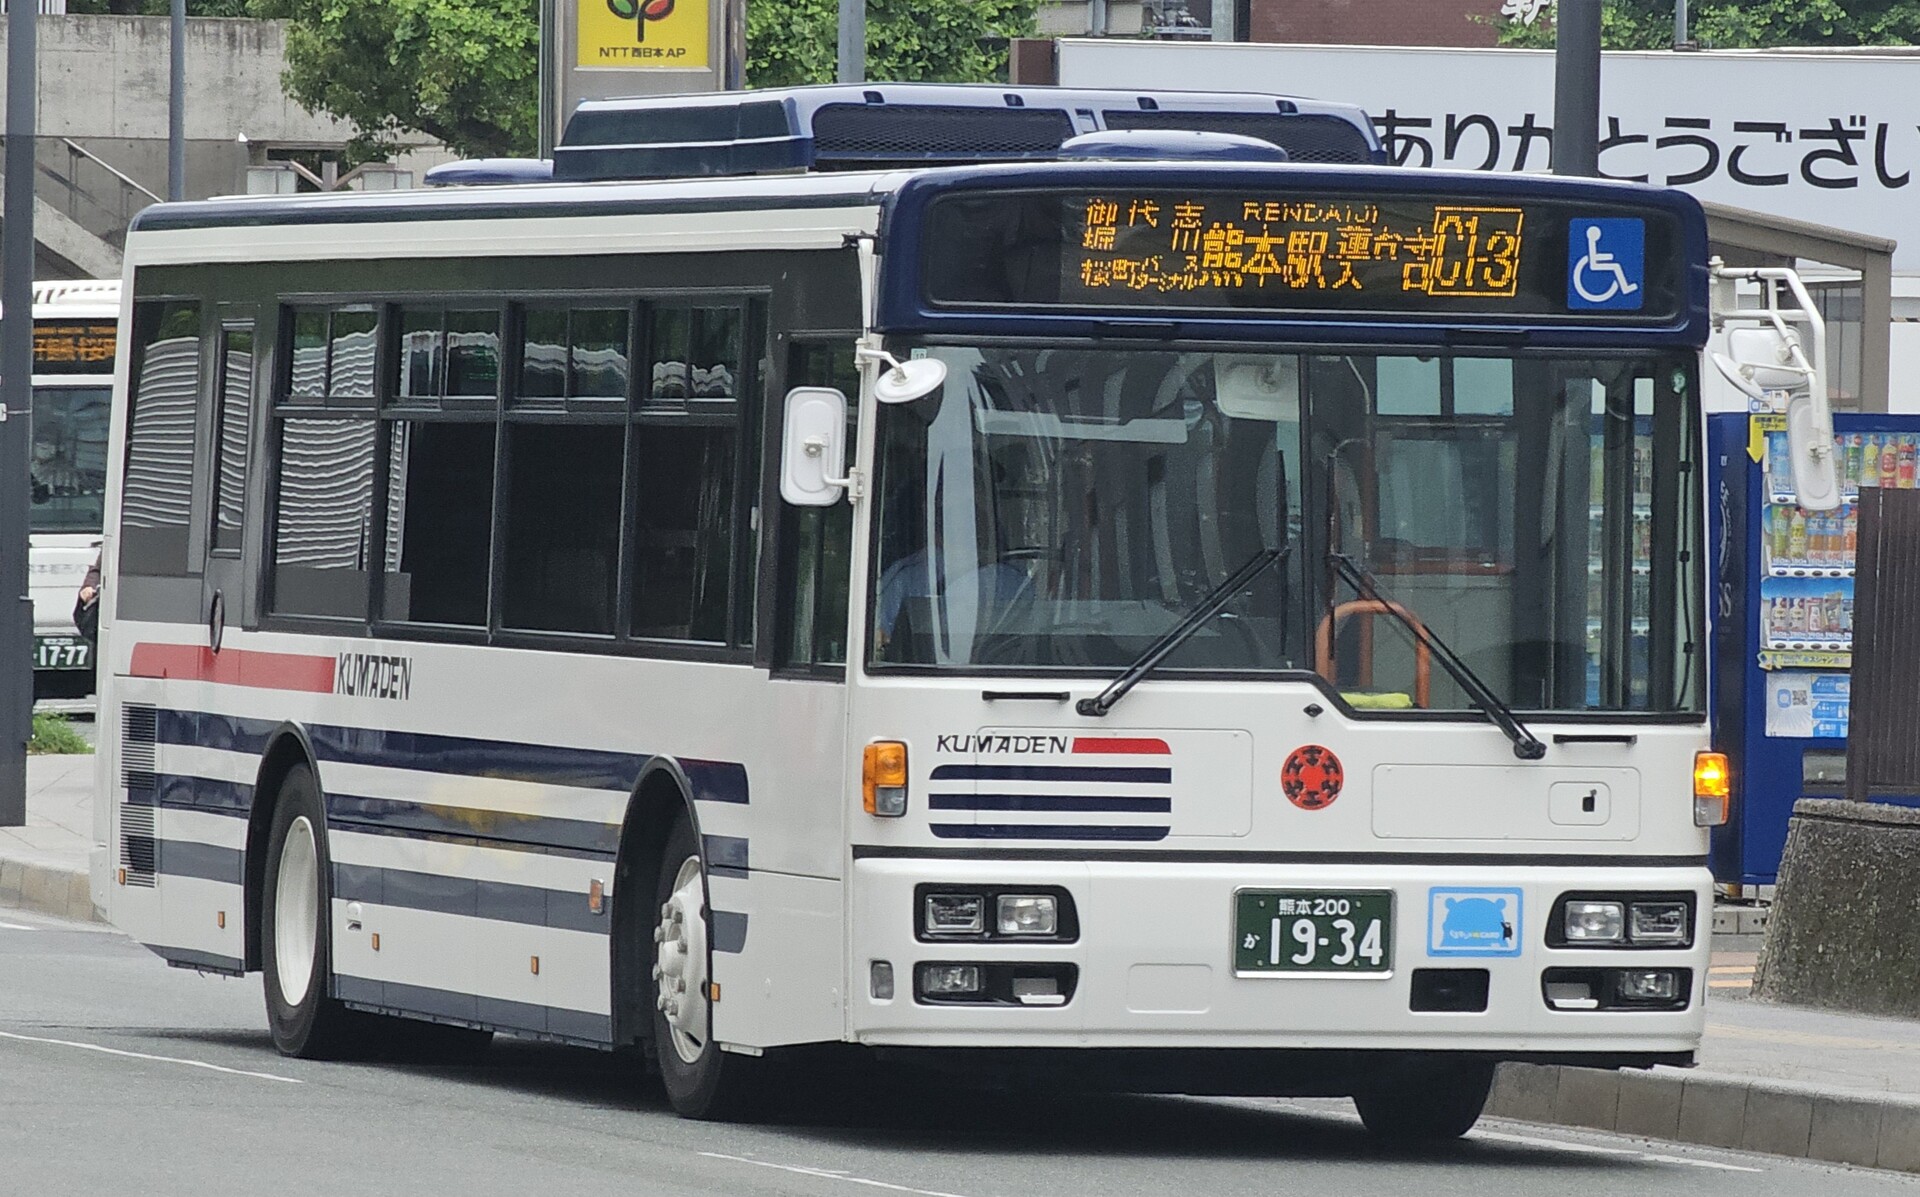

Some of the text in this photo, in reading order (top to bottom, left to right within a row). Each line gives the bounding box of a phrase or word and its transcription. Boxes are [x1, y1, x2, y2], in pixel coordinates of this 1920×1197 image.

[1201, 222, 1328, 289] 熊本駅
[40, 645, 88, 666] 17-77
[337, 652, 412, 700] KUMADEN
[937, 734, 1067, 753] KUMADEN
[1244, 918, 1383, 965] か 19-34
